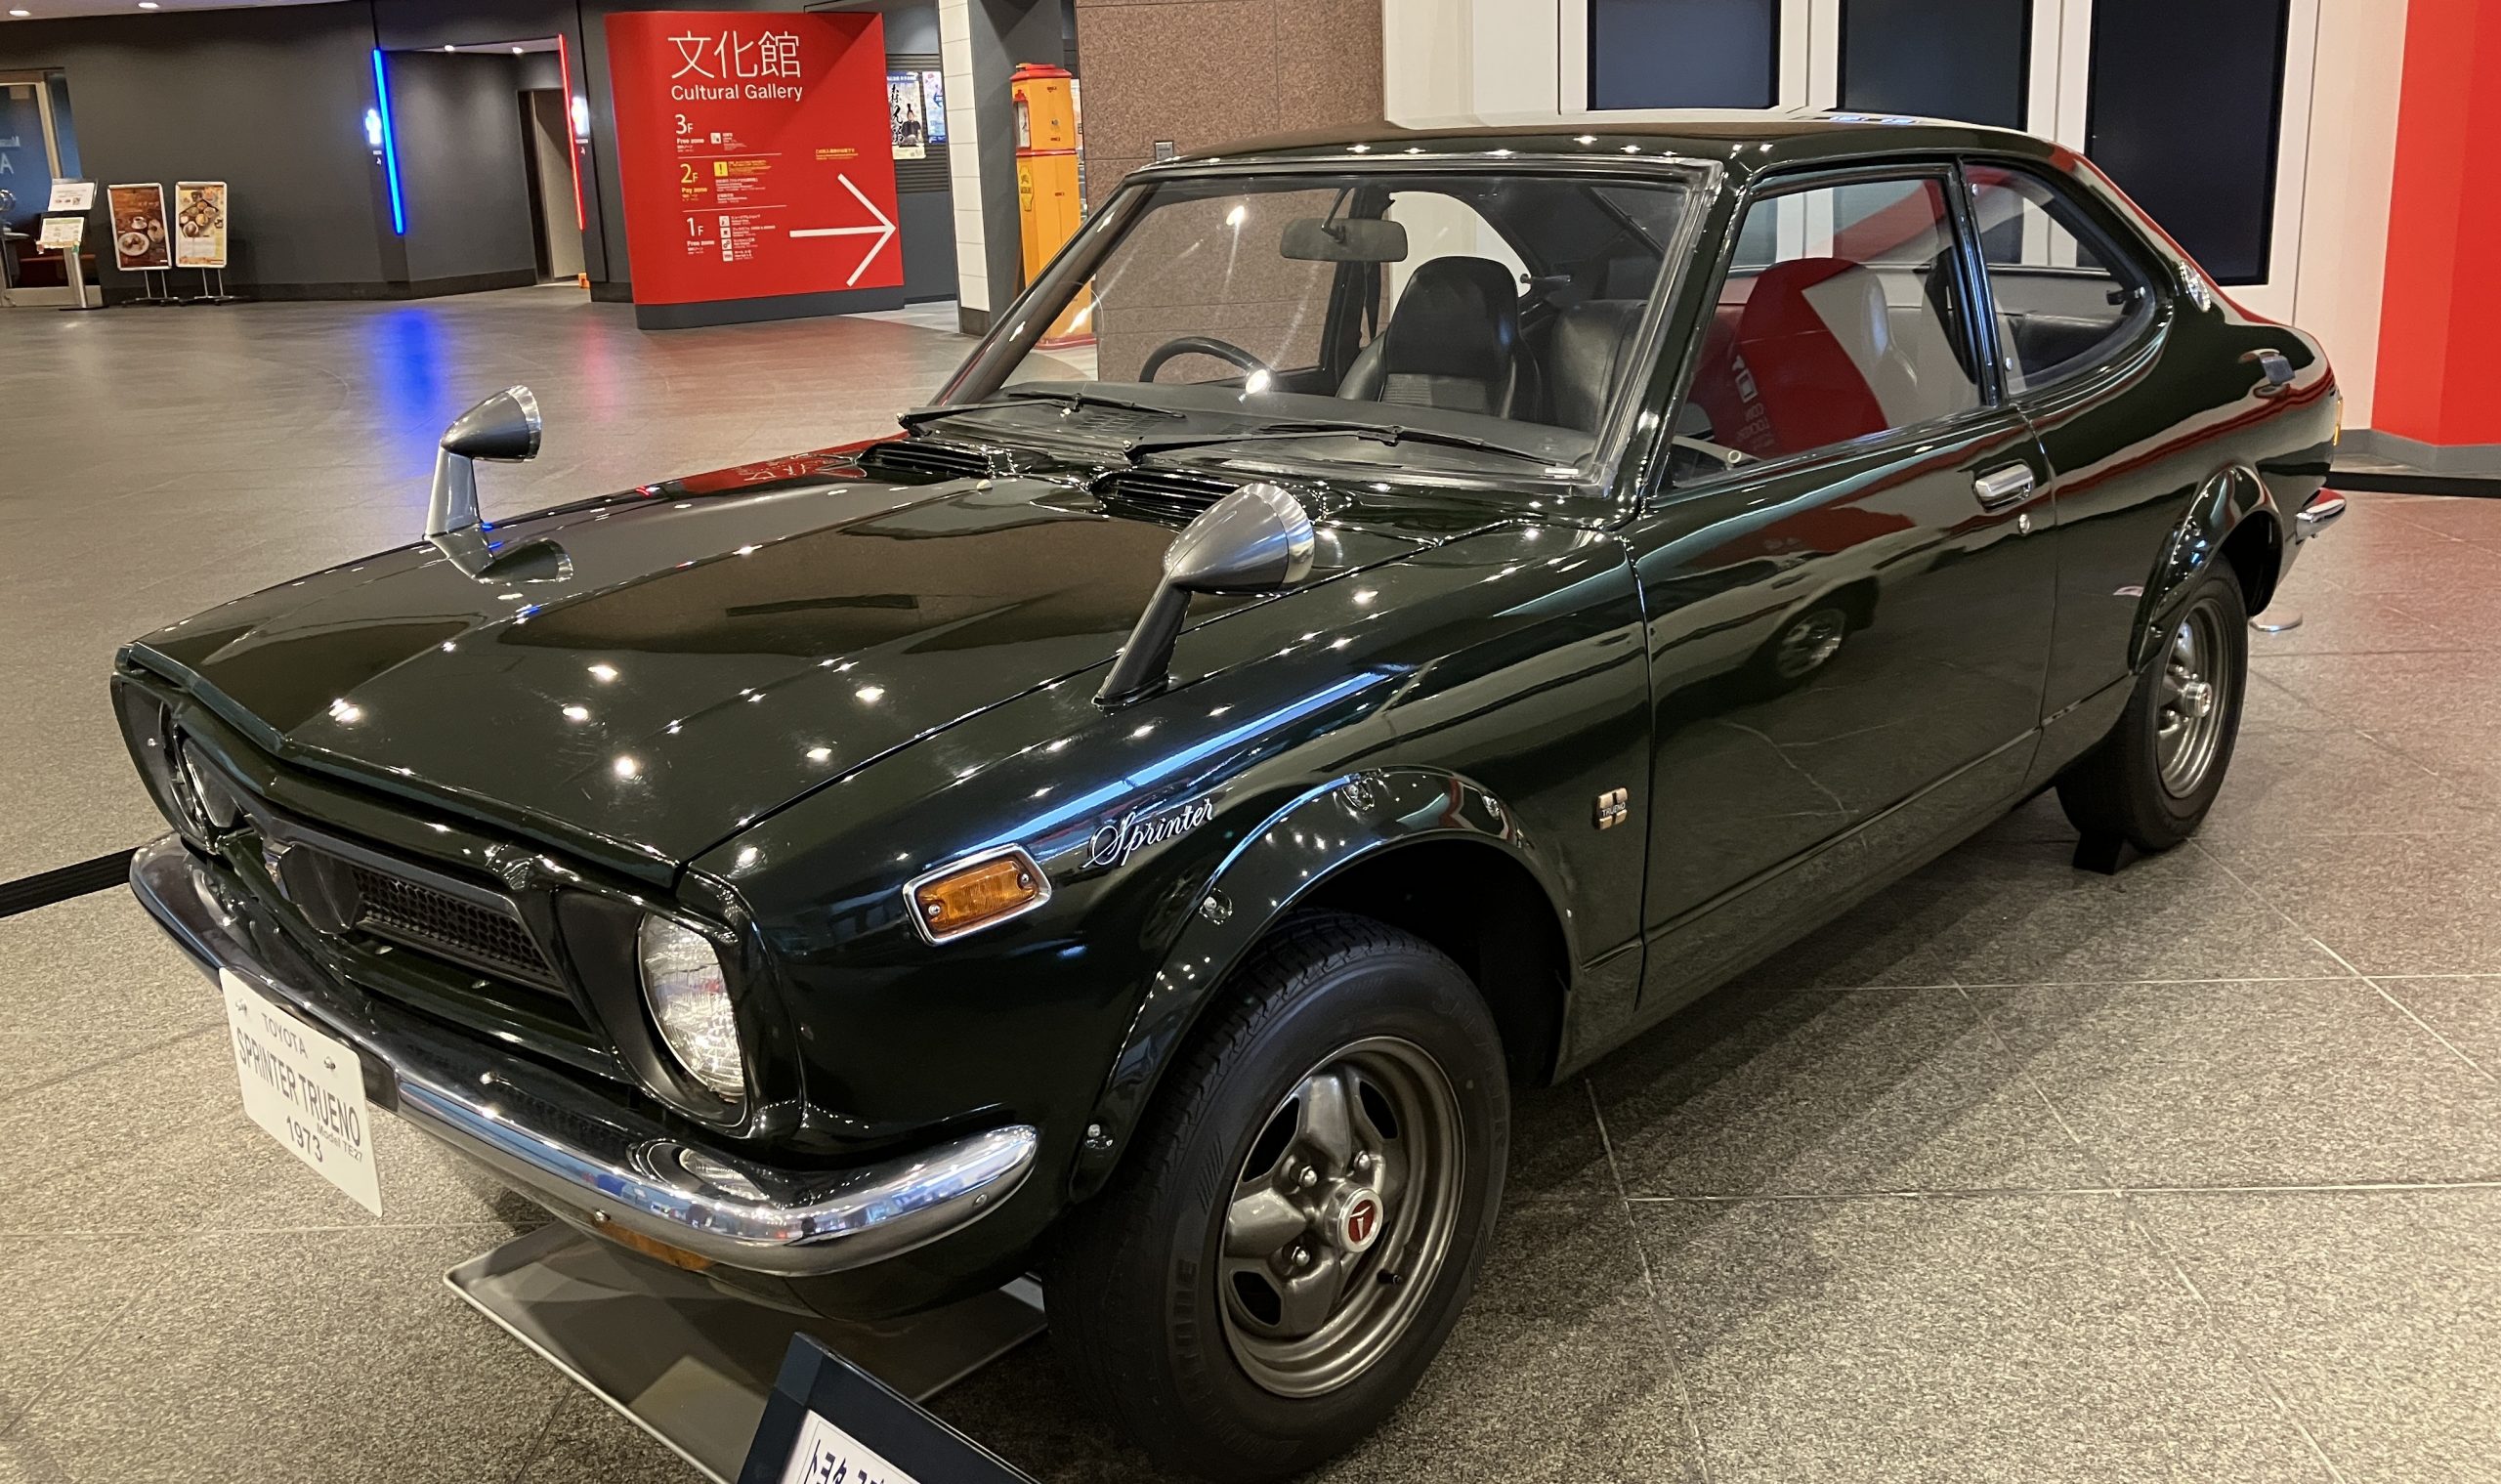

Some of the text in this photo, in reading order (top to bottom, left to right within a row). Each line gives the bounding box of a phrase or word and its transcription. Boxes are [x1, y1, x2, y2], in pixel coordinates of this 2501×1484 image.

[667, 30, 800, 78] 文化館
[671, 83, 803, 102] Cultural Gallery
[675, 114, 693, 135] 3F
[680, 163, 699, 184] 2F
[687, 217, 704, 236] 1F
[1602, 802, 1626, 817] TRUENO
[1079, 797, 1213, 869] Sprinter
[261, 1012, 309, 1060] TOYOTA
[236, 1027, 360, 1147] SPRINTER TRUENO
[286, 1116, 323, 1164] 1973
[317, 1123, 362, 1164] Model TE27
